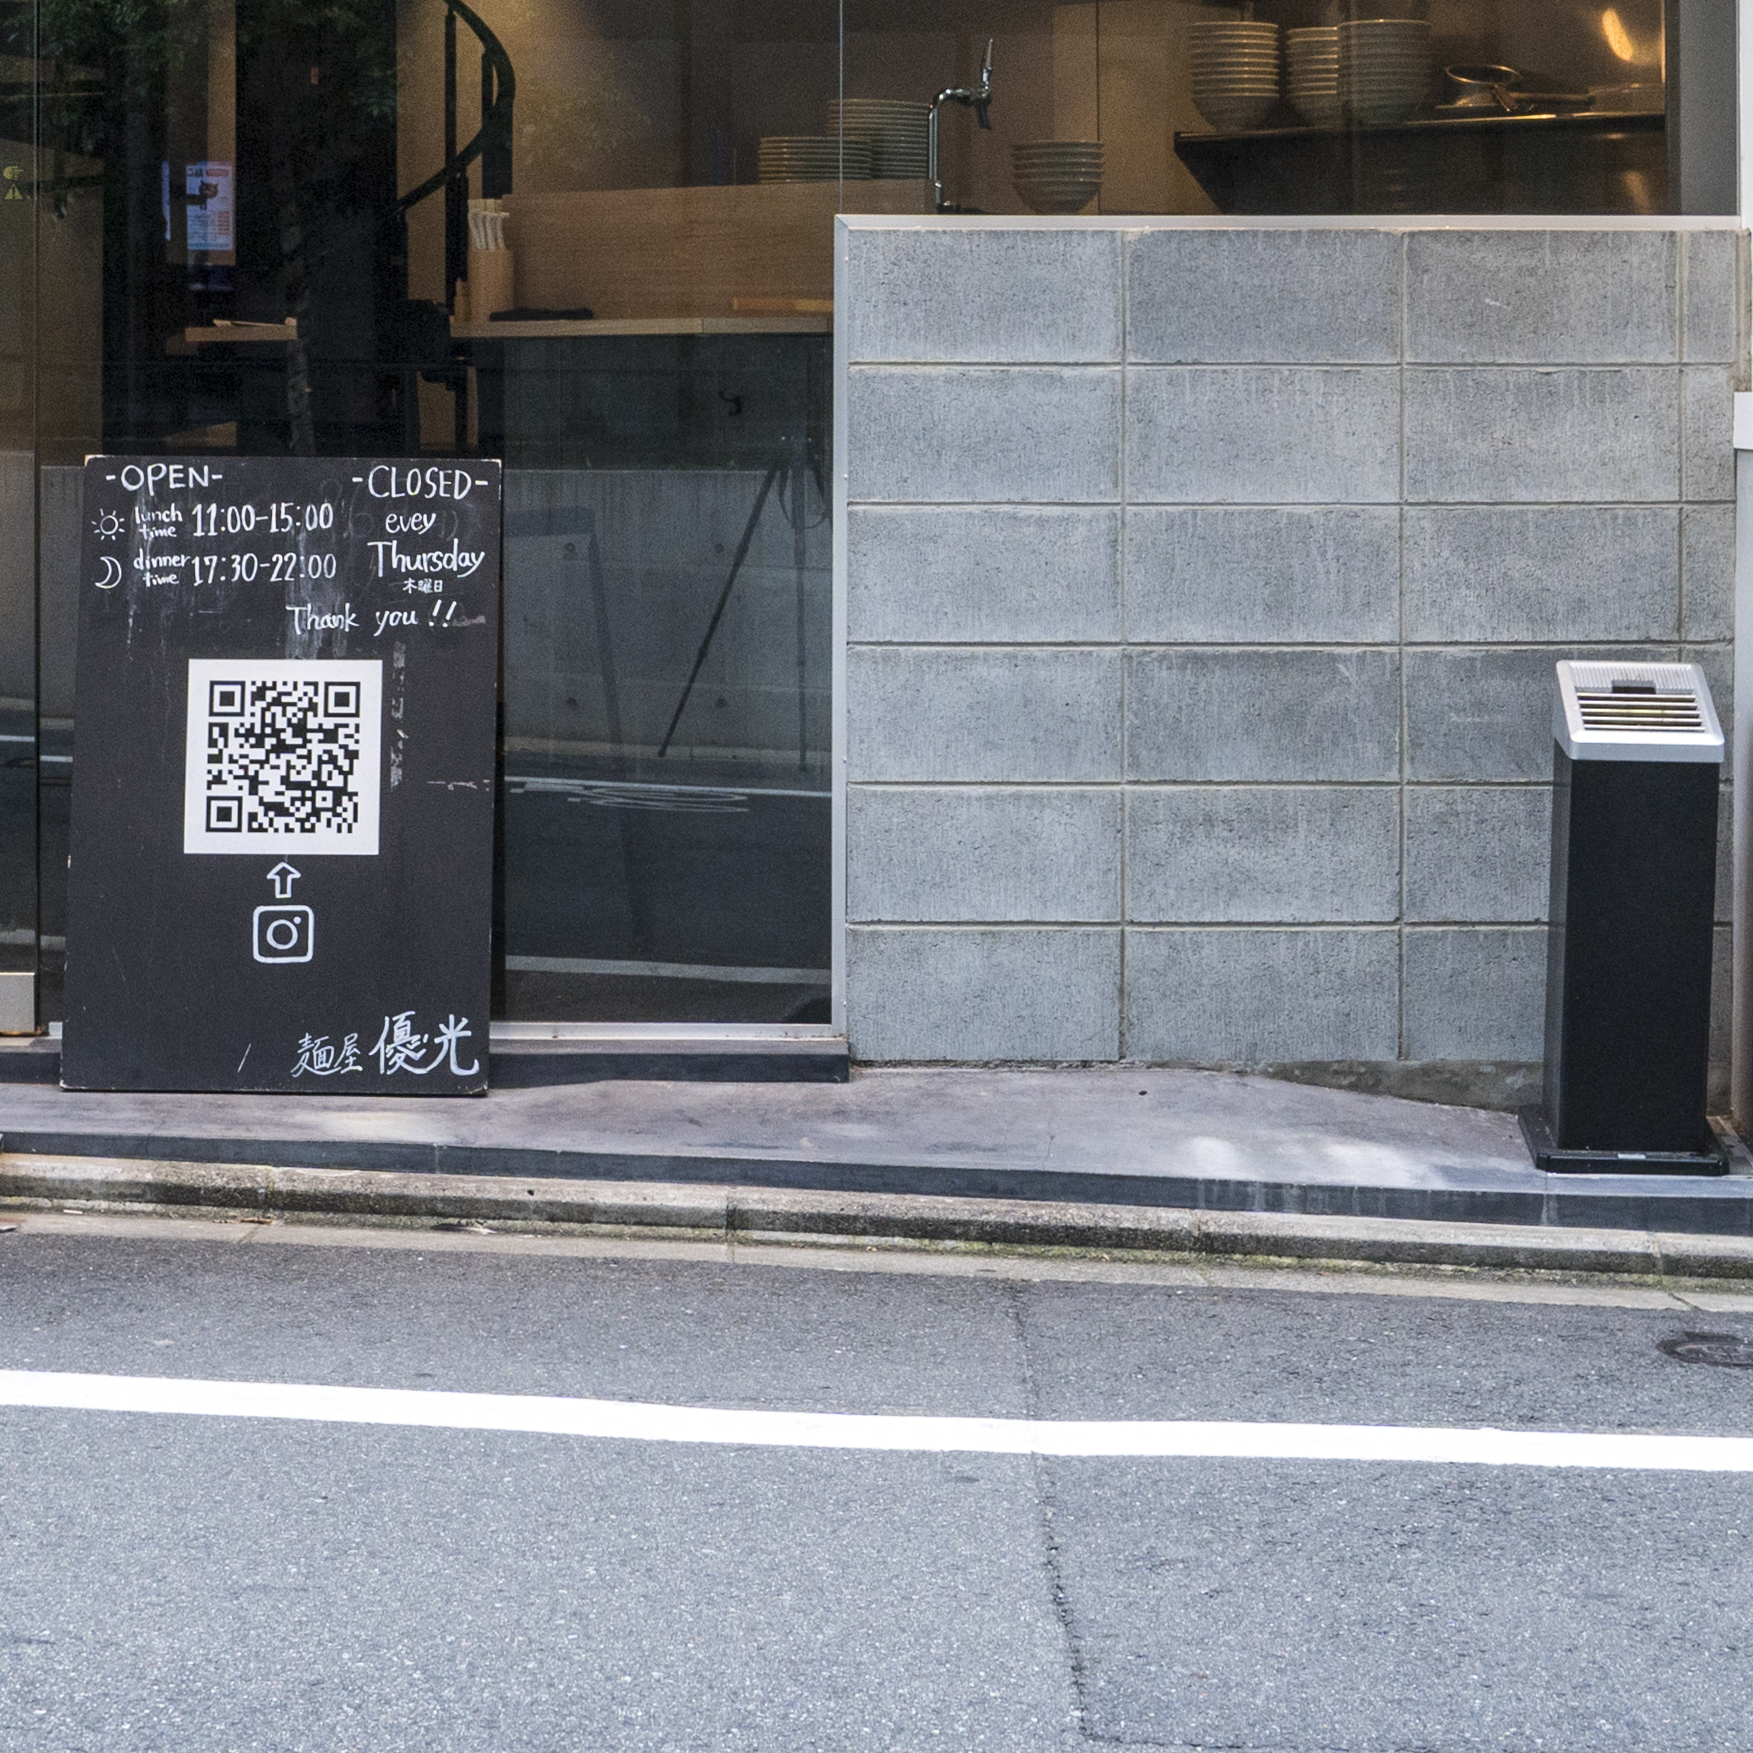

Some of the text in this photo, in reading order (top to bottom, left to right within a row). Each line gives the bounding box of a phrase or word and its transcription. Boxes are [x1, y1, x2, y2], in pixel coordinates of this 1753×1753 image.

[134, 502, 334, 537] lunch 11:00-15:00
[139, 524, 178, 540] time
[385, 512, 437, 535] evey
[133, 548, 337, 587] dinner 17:30-22:00
[366, 538, 486, 578] Thursday
[142, 571, 180, 588] time
[402, 578, 444, 594] 木曜日
[285, 602, 360, 636] Thank
[373, 610, 419, 638] you
